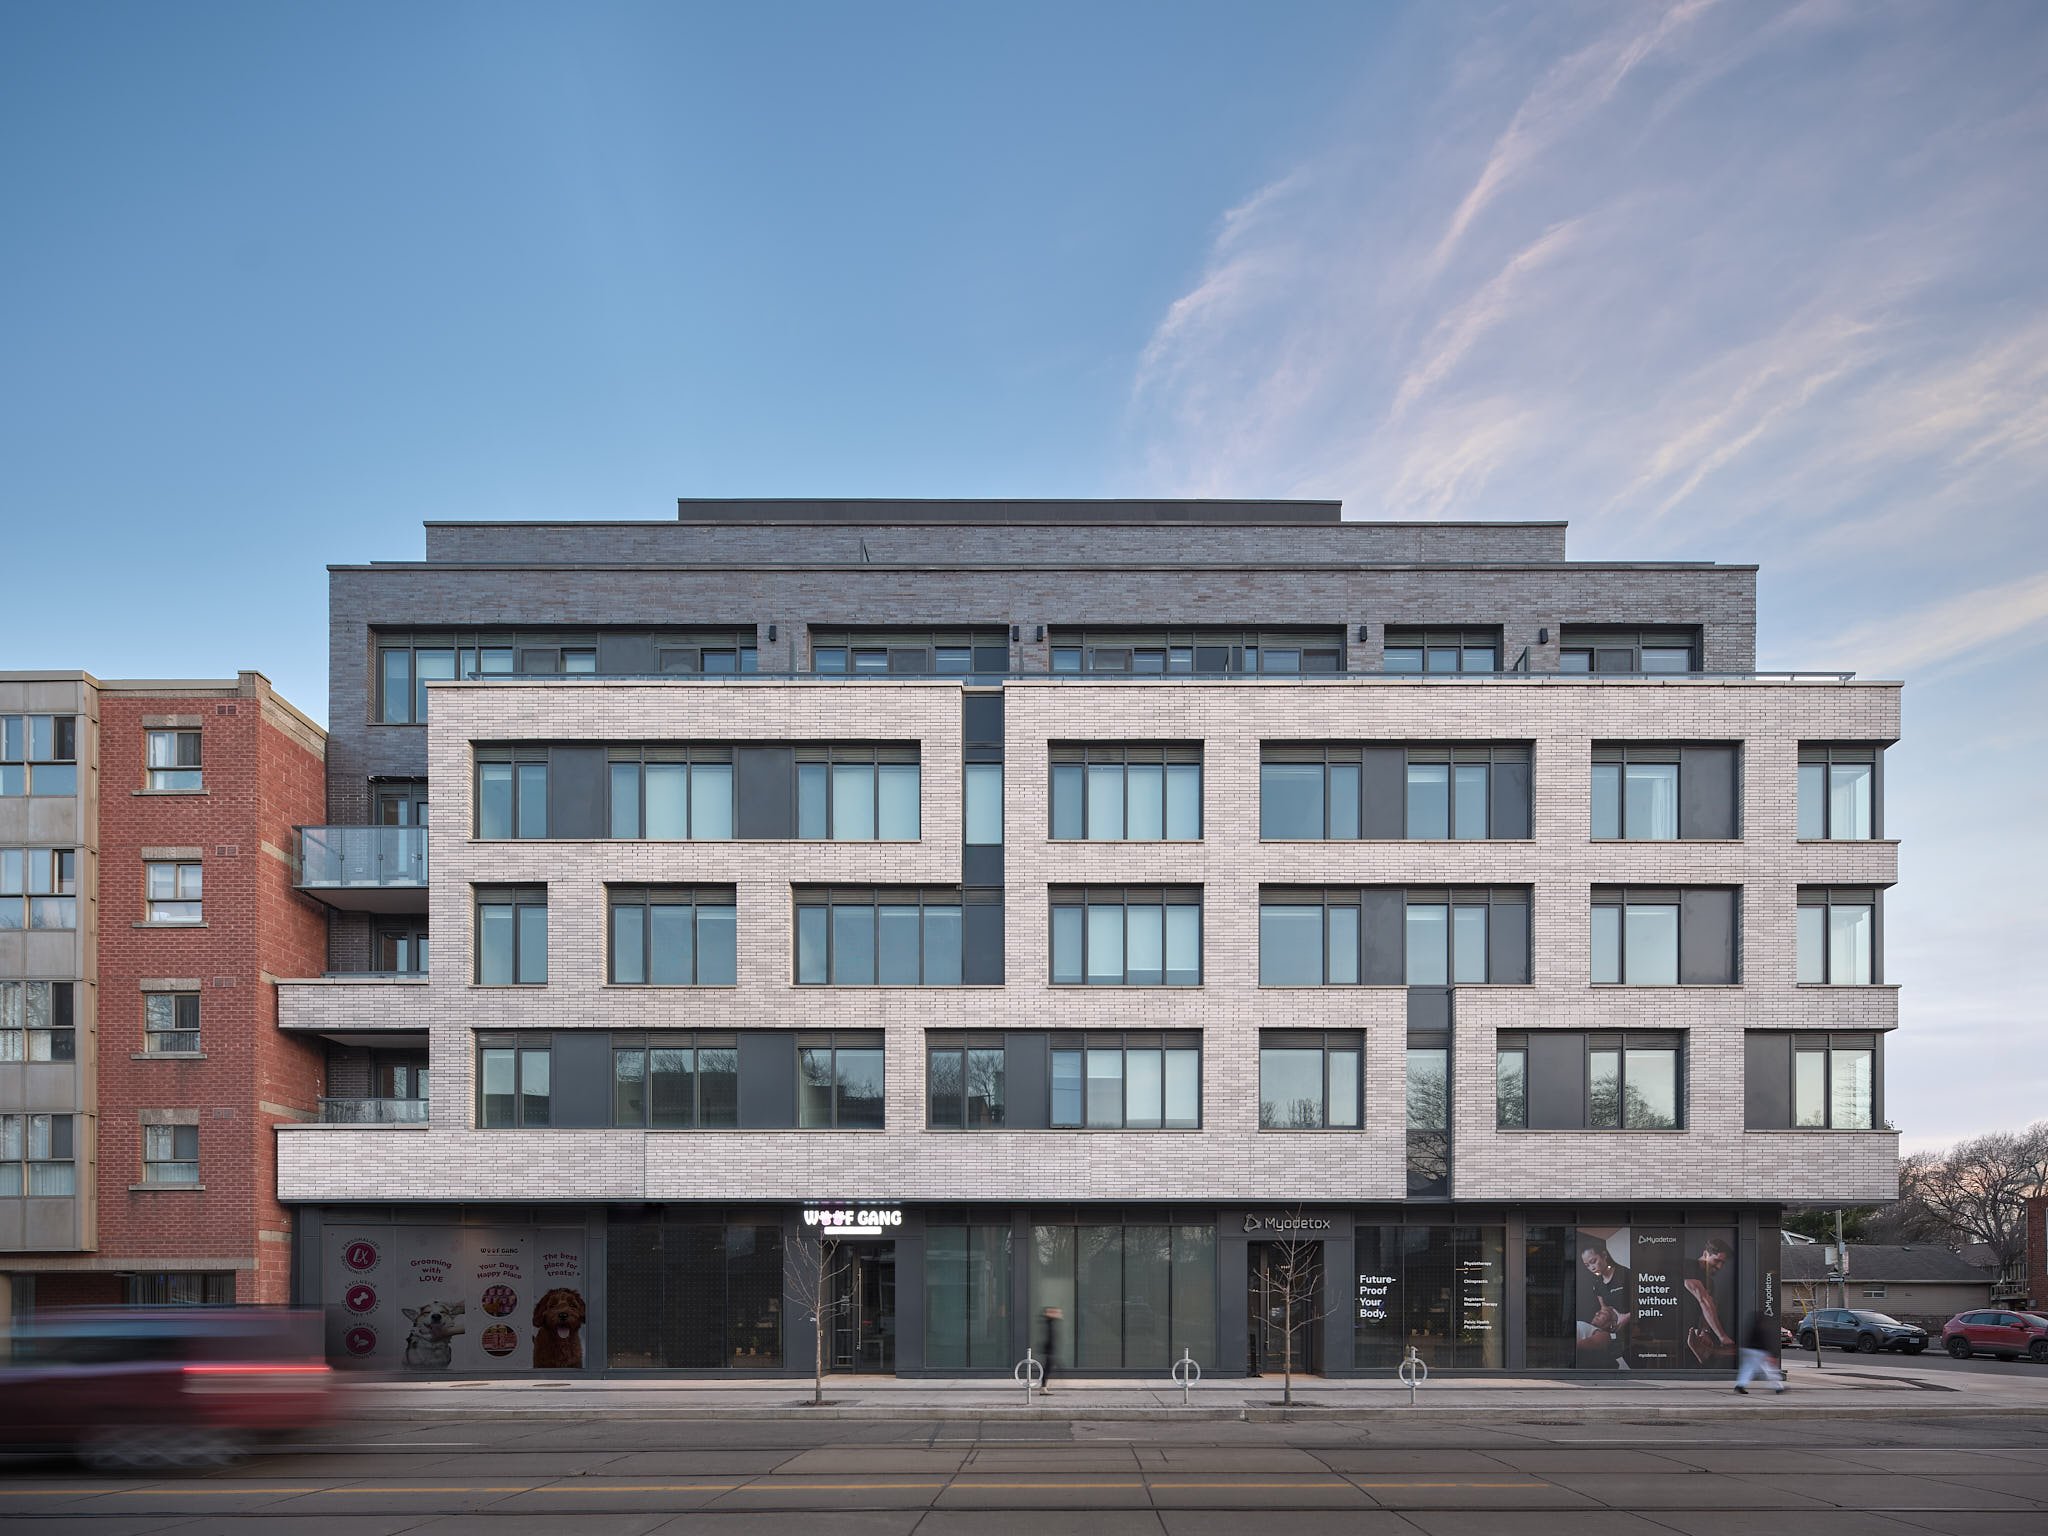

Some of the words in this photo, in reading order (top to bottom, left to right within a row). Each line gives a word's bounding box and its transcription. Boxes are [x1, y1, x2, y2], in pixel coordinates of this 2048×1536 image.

[857, 1210, 902, 1226] GANG
[1265, 1217, 1330, 1232] Myodetox
[1646, 1236, 1676, 1244] Myodetox
[543, 1253, 558, 1261] The
[560, 1252, 577, 1261] best
[410, 1259, 452, 1269] Grooming
[544, 1262, 565, 1271] place
[419, 1275, 444, 1283] LOVE
[477, 1271, 501, 1279] Happy
[503, 1270, 522, 1280] Place
[1360, 1274, 1397, 1284] Future-
[1638, 1273, 1666, 1283] Move
[1360, 1286, 1388, 1295] Proof
[1638, 1285, 1670, 1294] better
[1764, 1272, 1774, 1308] Myodetox
[1359, 1297, 1383, 1306] Your
[1638, 1296, 1678, 1306] without
[1360, 1309, 1387, 1320] Body.
[1638, 1308, 1664, 1319] pain.
